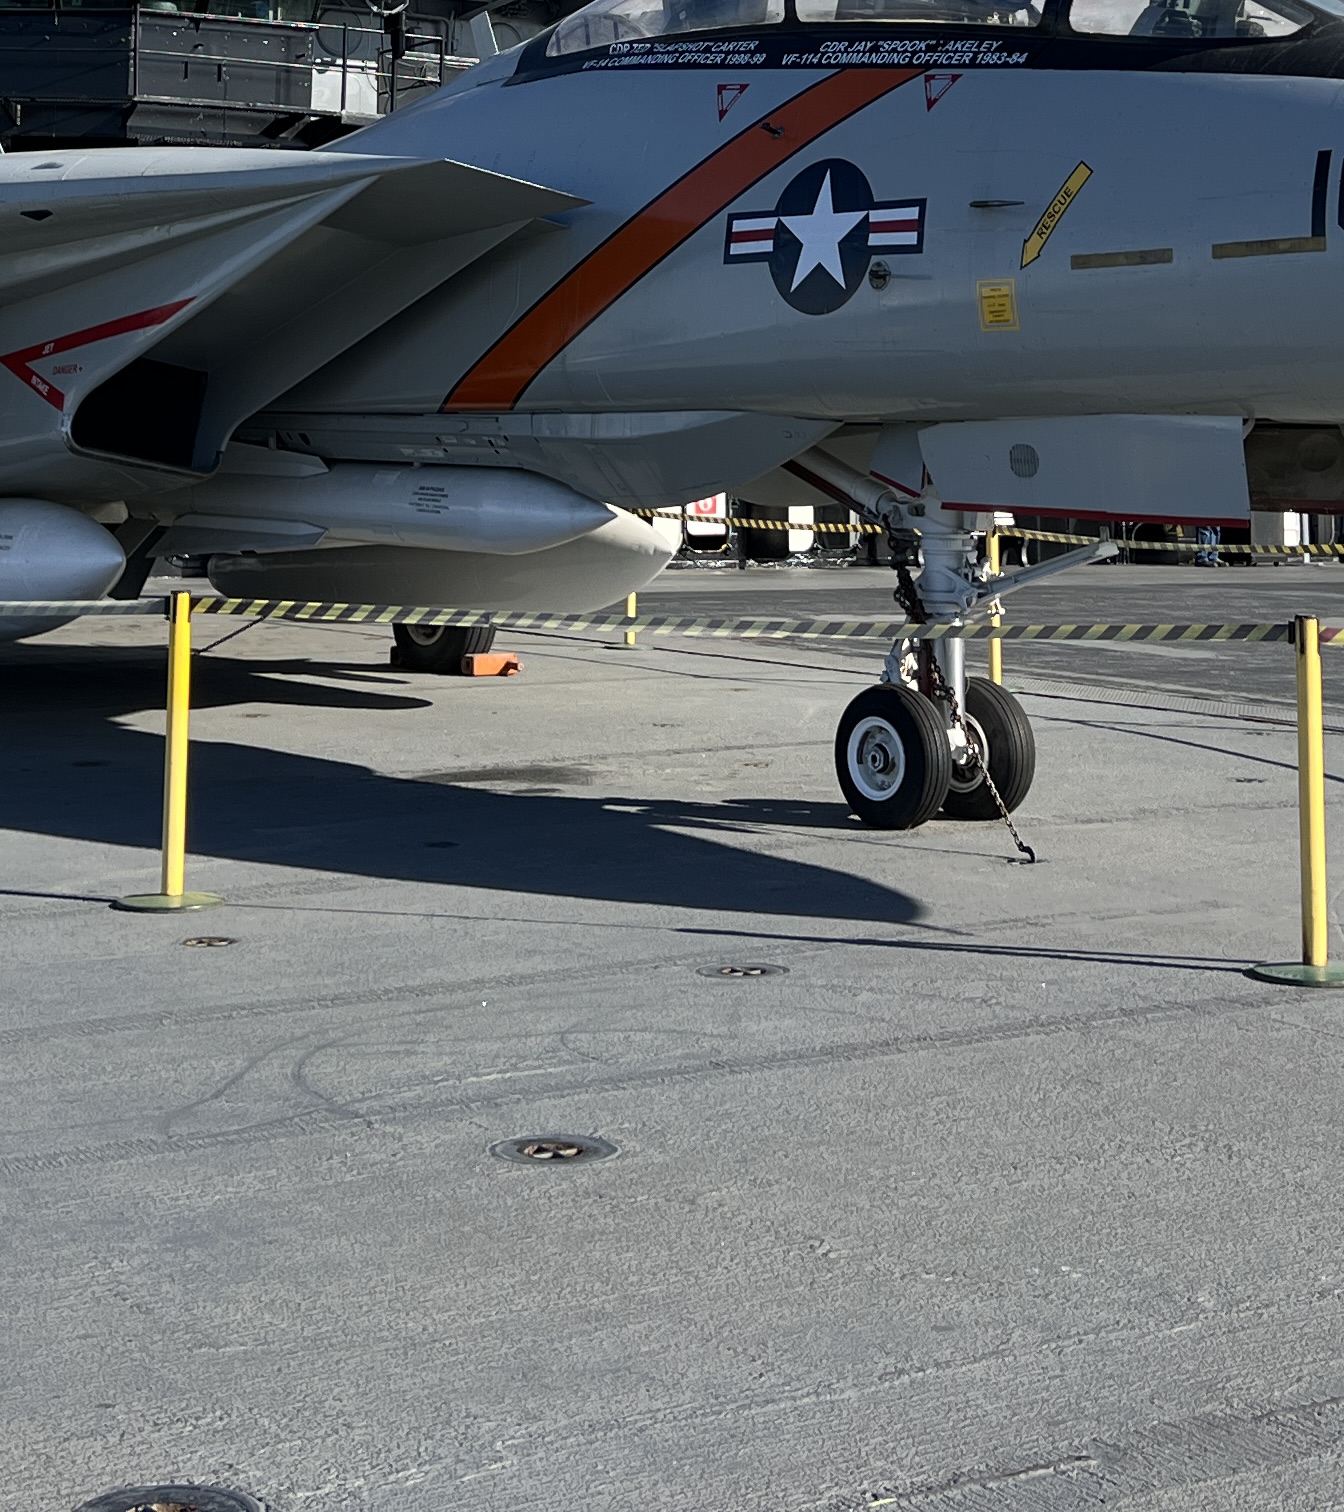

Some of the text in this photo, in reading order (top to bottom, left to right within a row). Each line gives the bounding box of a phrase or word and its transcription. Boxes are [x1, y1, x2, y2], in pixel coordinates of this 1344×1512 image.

[712, 40, 760, 52] CARTER
[819, 41, 849, 52] CDR
[847, 40, 876, 52] JAY
[877, 40, 936, 51] "SPOOK"
[607, 53, 678, 67] COMMANDING
[678, 52, 727, 65] OFFICER
[781, 52, 1029, 66] VF-114 COMMANDING OFFICER 1983-84
[1036, 186, 1074, 240] RESCUE
[42, 342, 55, 355] JET
